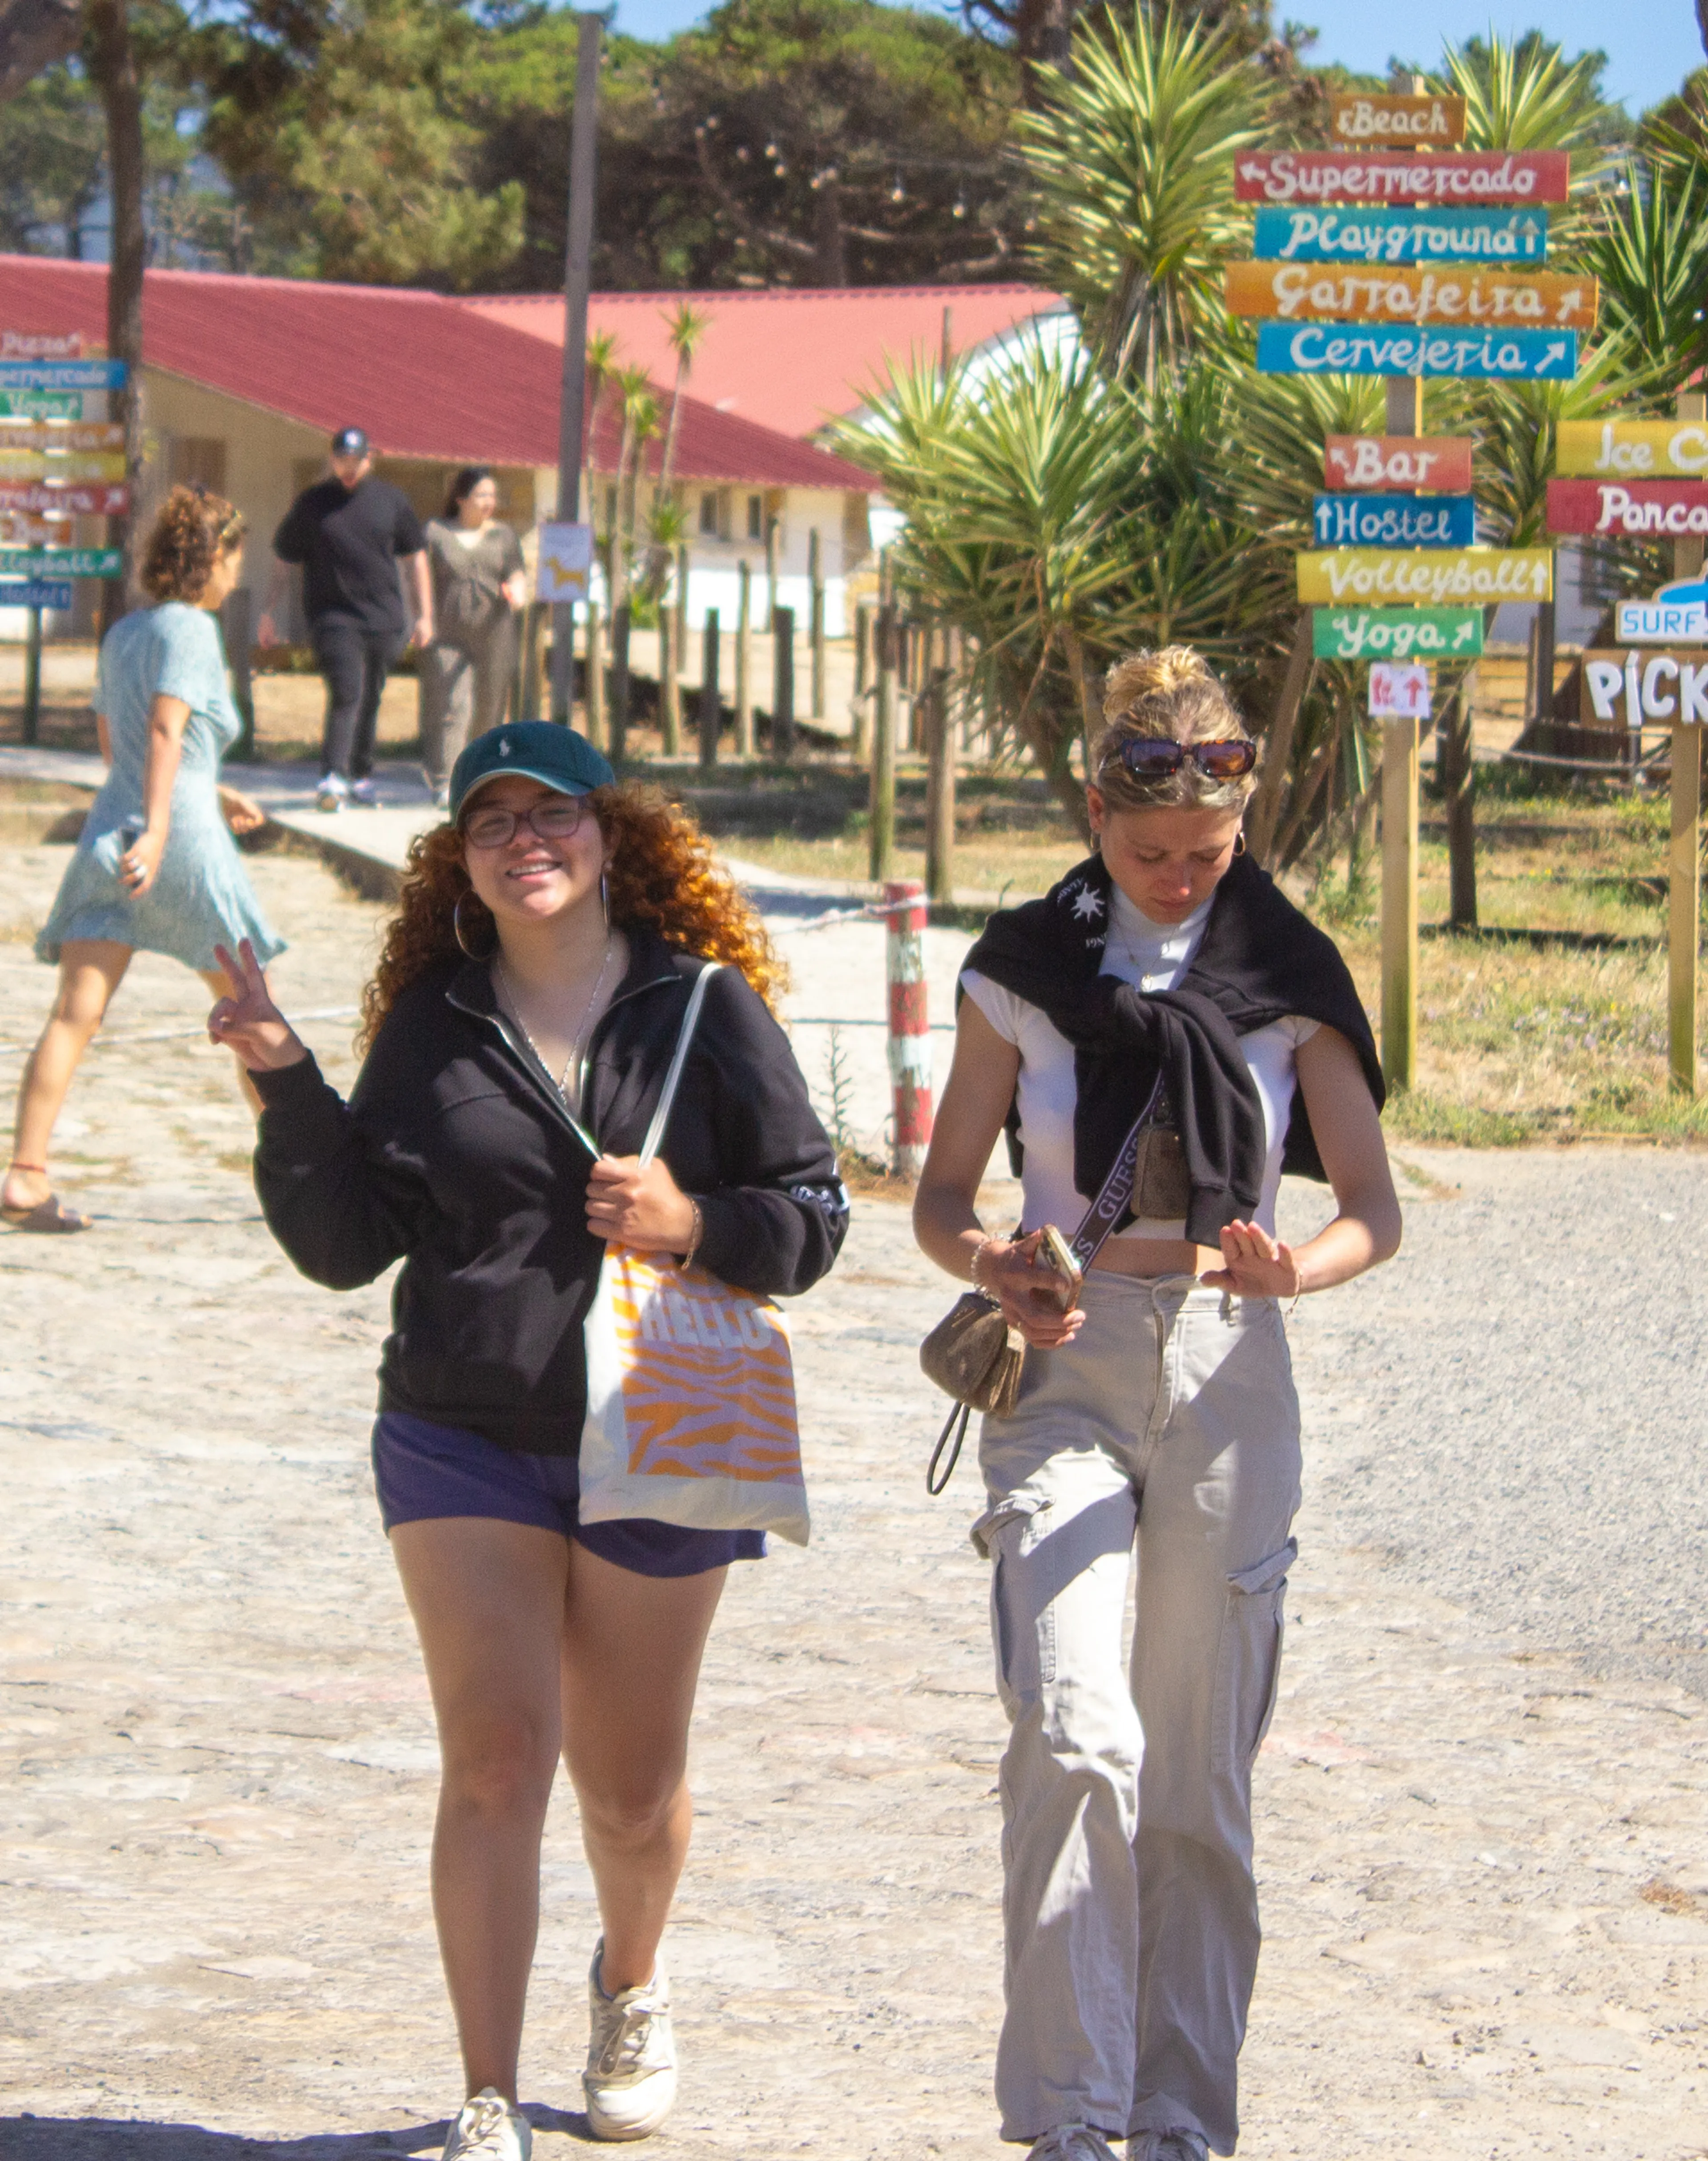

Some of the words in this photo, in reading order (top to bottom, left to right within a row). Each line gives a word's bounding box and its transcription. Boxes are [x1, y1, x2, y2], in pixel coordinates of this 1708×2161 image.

[1346, 101, 1448, 137] Beach
[1264, 155, 1537, 200] Supermercado
[1279, 211, 1519, 260] Playground
[1271, 265, 1547, 319] Garrafeira
[1290, 327, 1527, 376] Cervejeria
[1344, 439, 1438, 486] Bar
[1594, 423, 1654, 471] Ice
[1668, 428, 1708, 472] C
[1334, 499, 1452, 541] Hostel
[1320, 558, 1528, 602] Volleyball
[1333, 615, 1446, 657] Yoga
[1624, 609, 1701, 634] SURF
